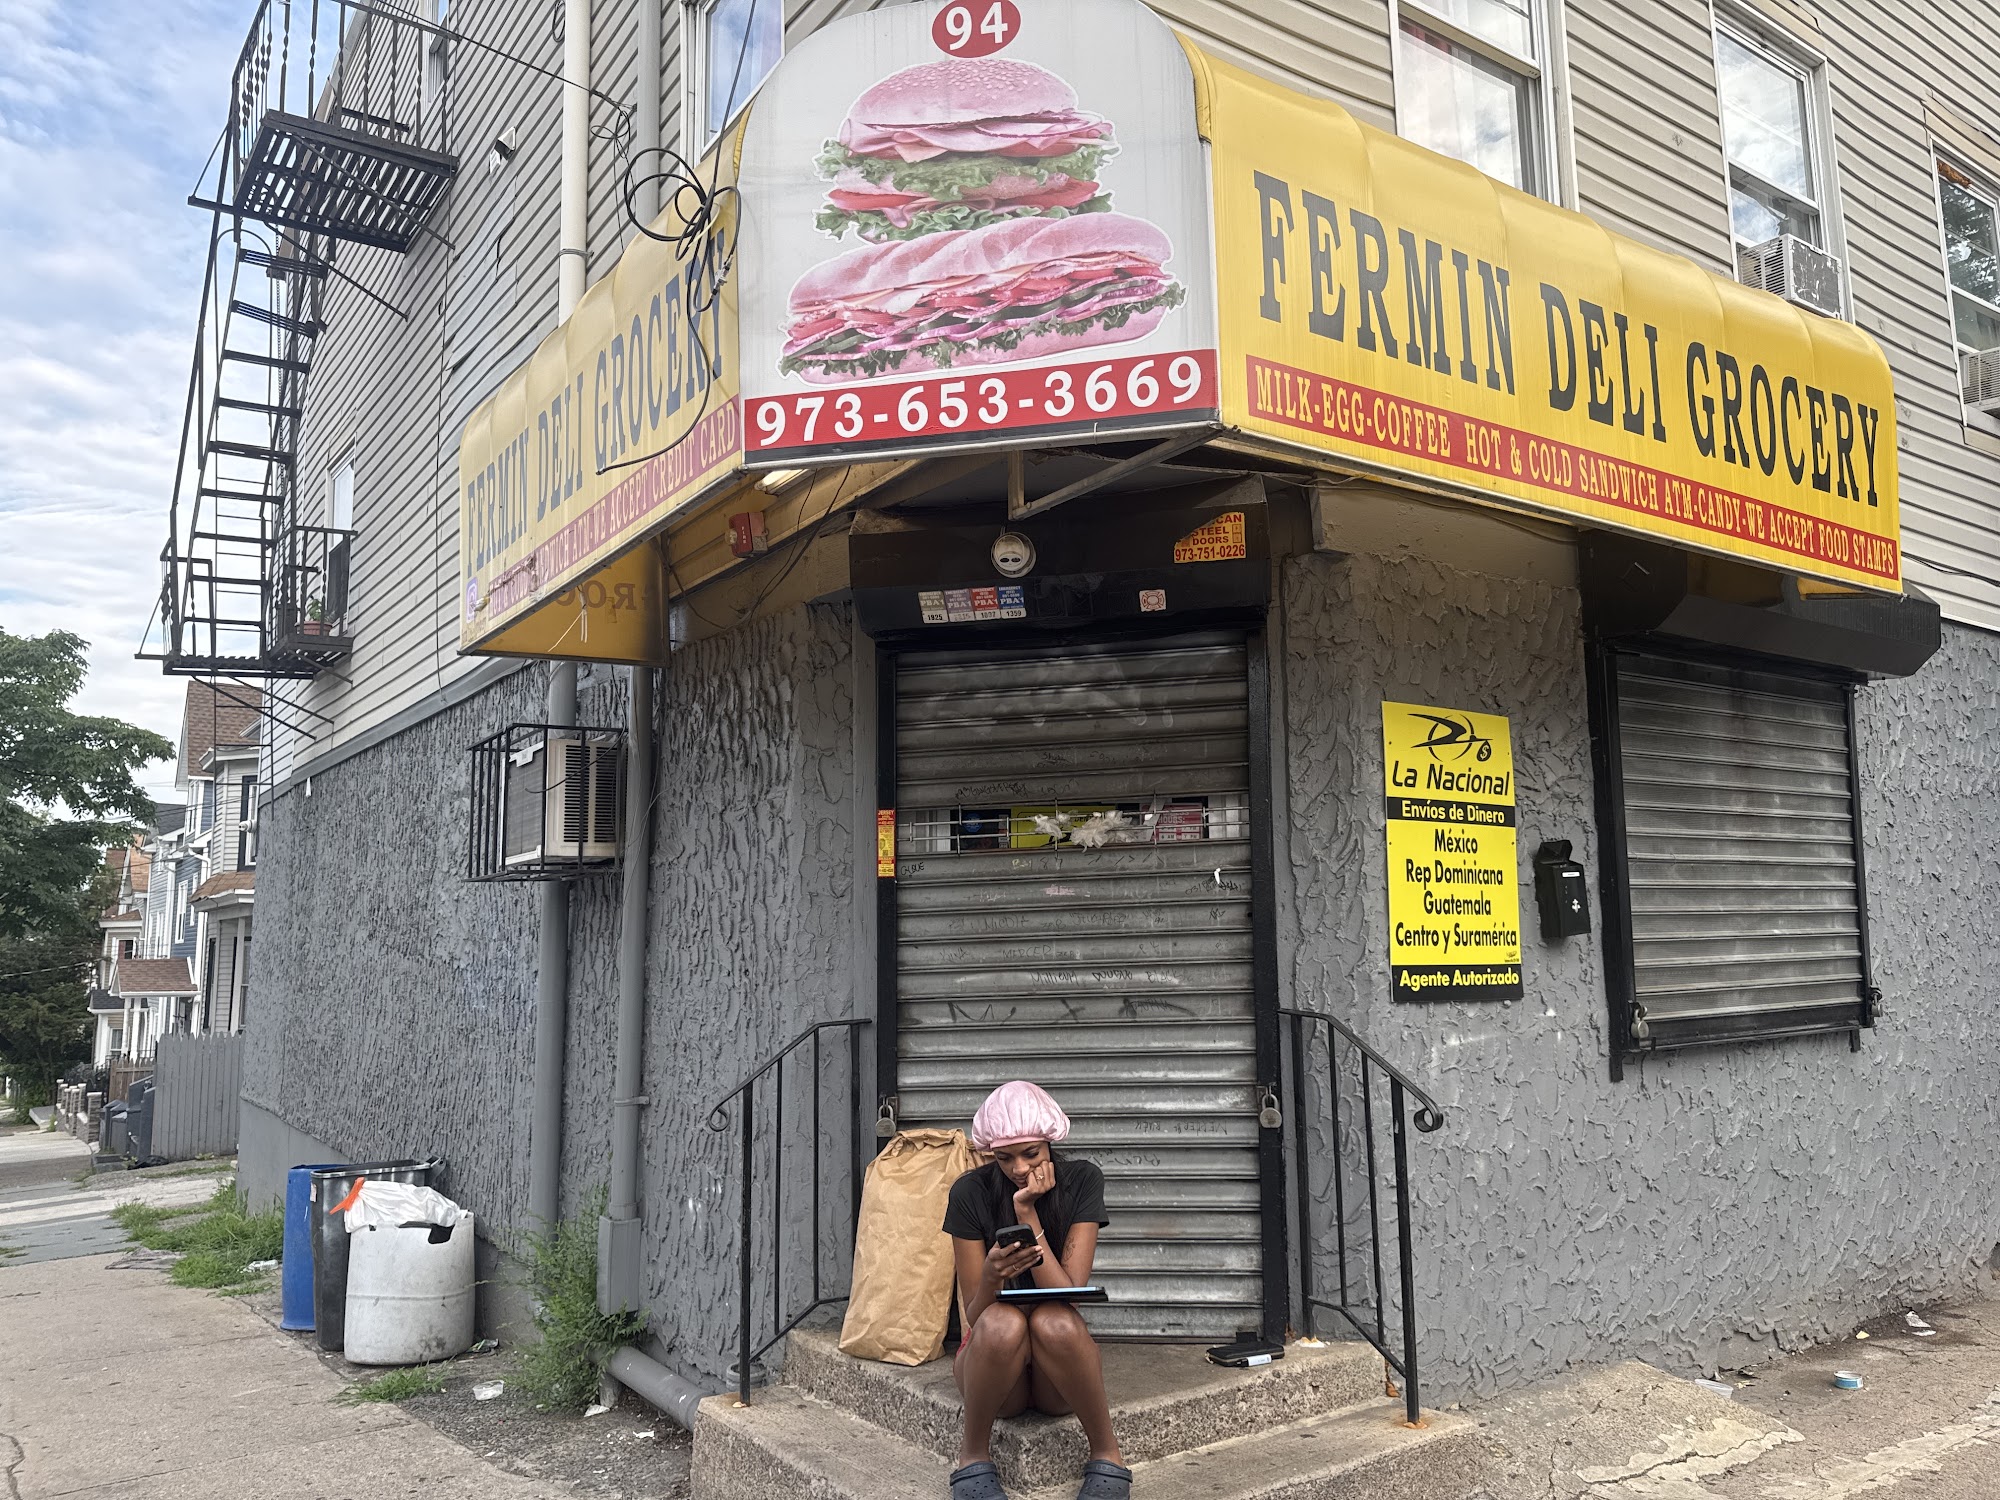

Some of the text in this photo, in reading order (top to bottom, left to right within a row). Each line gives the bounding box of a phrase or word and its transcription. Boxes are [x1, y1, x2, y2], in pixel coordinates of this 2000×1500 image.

[945, 2, 1009, 51] 94
[1254, 170, 1879, 508] FERMIN DELI GROCERY
[467, 227, 726, 578] FERMIN DELI GROCERY
[756, 356, 1203, 447] 973-653-3669
[609, 467, 648, 534] ACCEPT
[652, 434, 695, 503] CREDIT
[700, 401, 736, 469] CARD
[1255, 365, 1895, 575] MILK-EGG-COFFEE HOT & COLD SANDWICH ATM-CANDY-WE ACCEPT FOOD STAMPS
[1192, 526, 1230, 537] STEEL
[1192, 536, 1229, 546] DOORS
[1175, 544, 1245, 561] 973-751-0226
[1392, 760, 1510, 796] La Nacional
[1401, 799, 1505, 823] Envíos de Dinero
[1434, 828, 1478, 854] México
[1406, 858, 1503, 890] Rep Dominicana
[1423, 890, 1491, 915] Guatemala
[1395, 921, 1517, 954] Centro y Suramérica
[1399, 966, 1520, 992] Agente Autorizado
